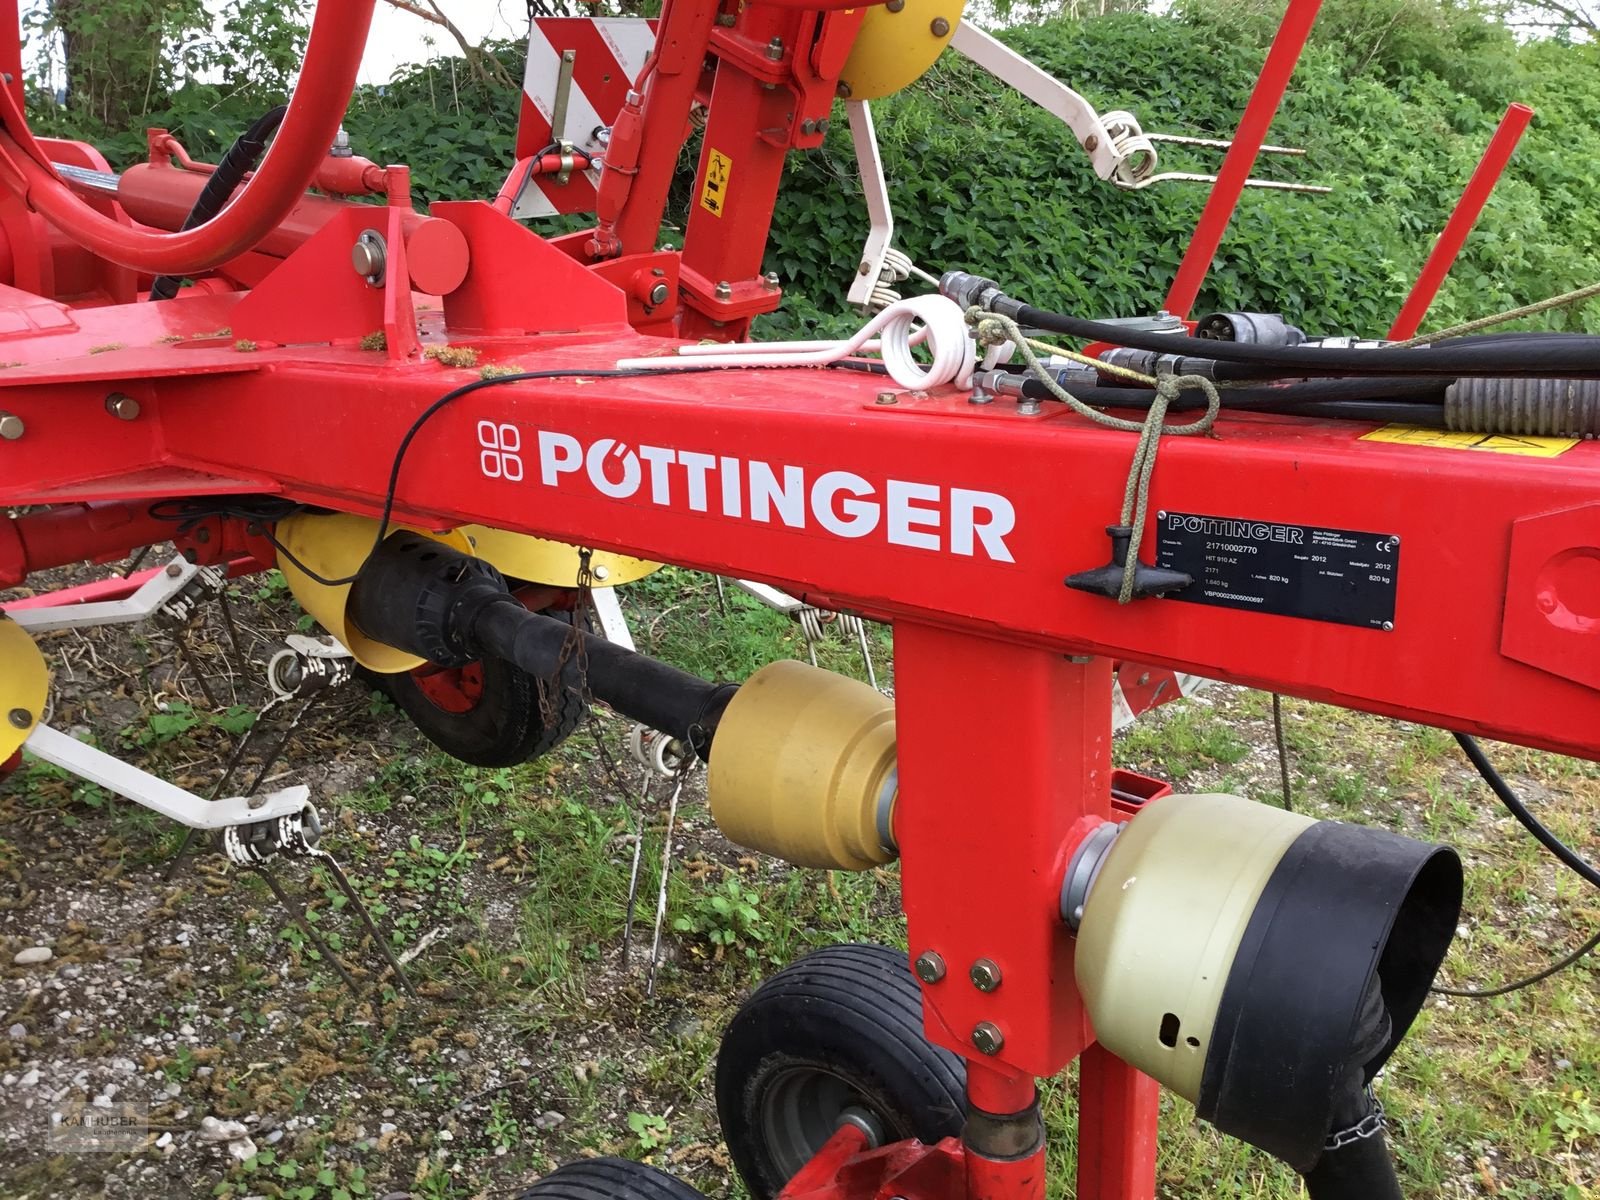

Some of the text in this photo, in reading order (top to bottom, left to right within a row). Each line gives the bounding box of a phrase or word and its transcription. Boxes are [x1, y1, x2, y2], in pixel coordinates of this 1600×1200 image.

[538, 430, 1016, 564] PÖTTINGER
[1168, 514, 1304, 545] PÖTTINGER
[1206, 541, 1257, 554] 21710002770
[1311, 555, 1327, 563] 2012
[1375, 562, 1391, 570] 2012
[1220, 580, 1229, 588] kg
[1269, 574, 1281, 582] 820
[1281, 576, 1289, 584] kg
[1368, 574, 1381, 582] 820
[1381, 575, 1390, 584] kg
